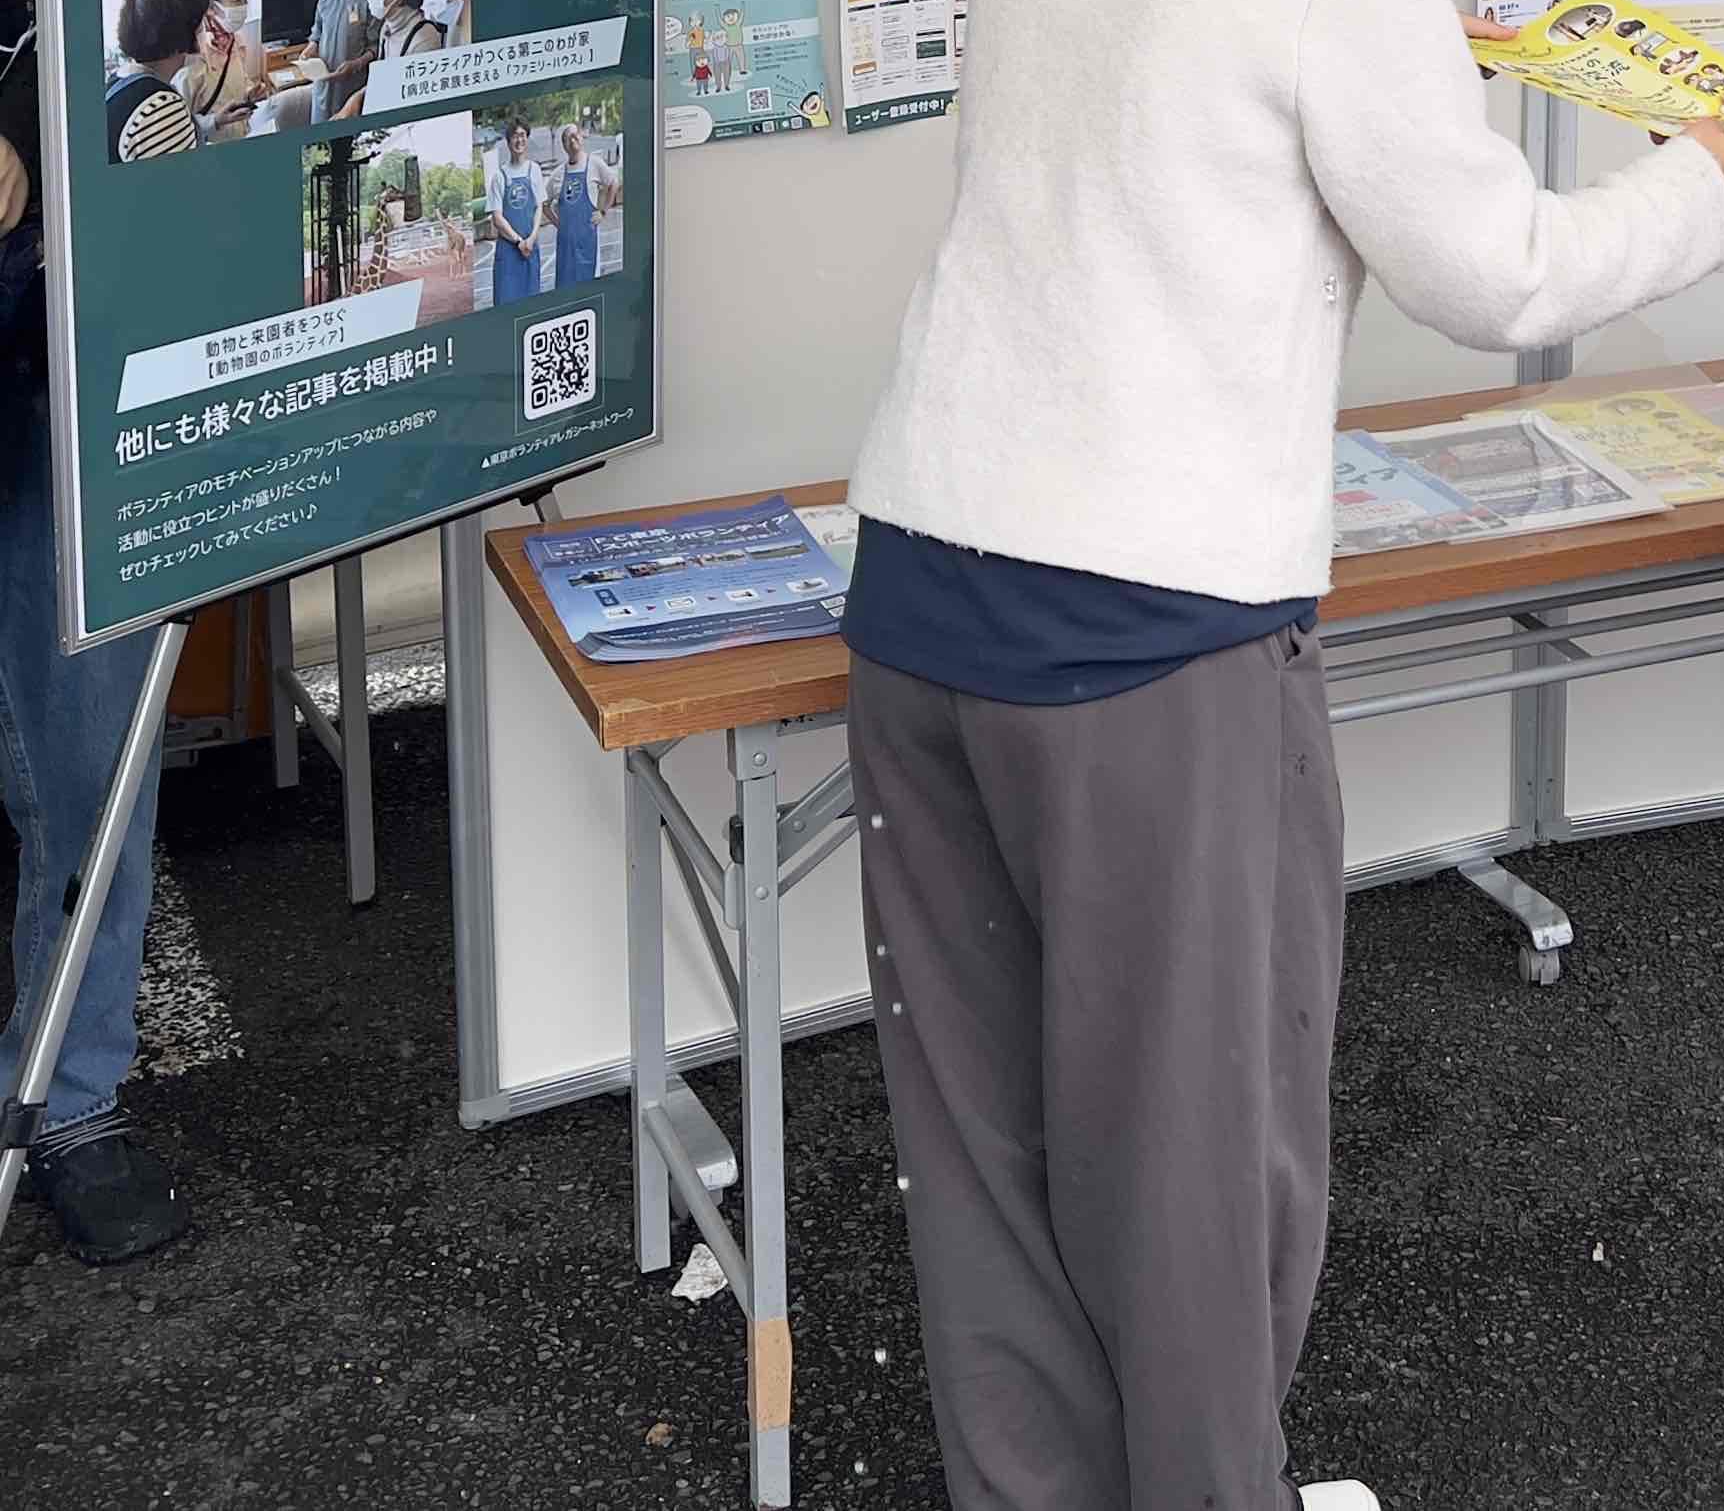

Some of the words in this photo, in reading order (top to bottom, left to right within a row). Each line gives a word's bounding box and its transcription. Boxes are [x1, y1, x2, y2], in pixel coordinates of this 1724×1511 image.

[404, 31, 590, 79] ボランティアがつくる第二のわが家
[205, 308, 347, 359] 動物と来園者をつなぐ
[206, 327, 347, 380] 【動物園のボランティア】
[115, 337, 455, 466] 他にも様々な記事を掲載中!
[117, 408, 437, 523] ボランティアのモチベーションアップにつながる内容や
[117, 466, 342, 554] 活動に役立つヒントが盛りだくさん!
